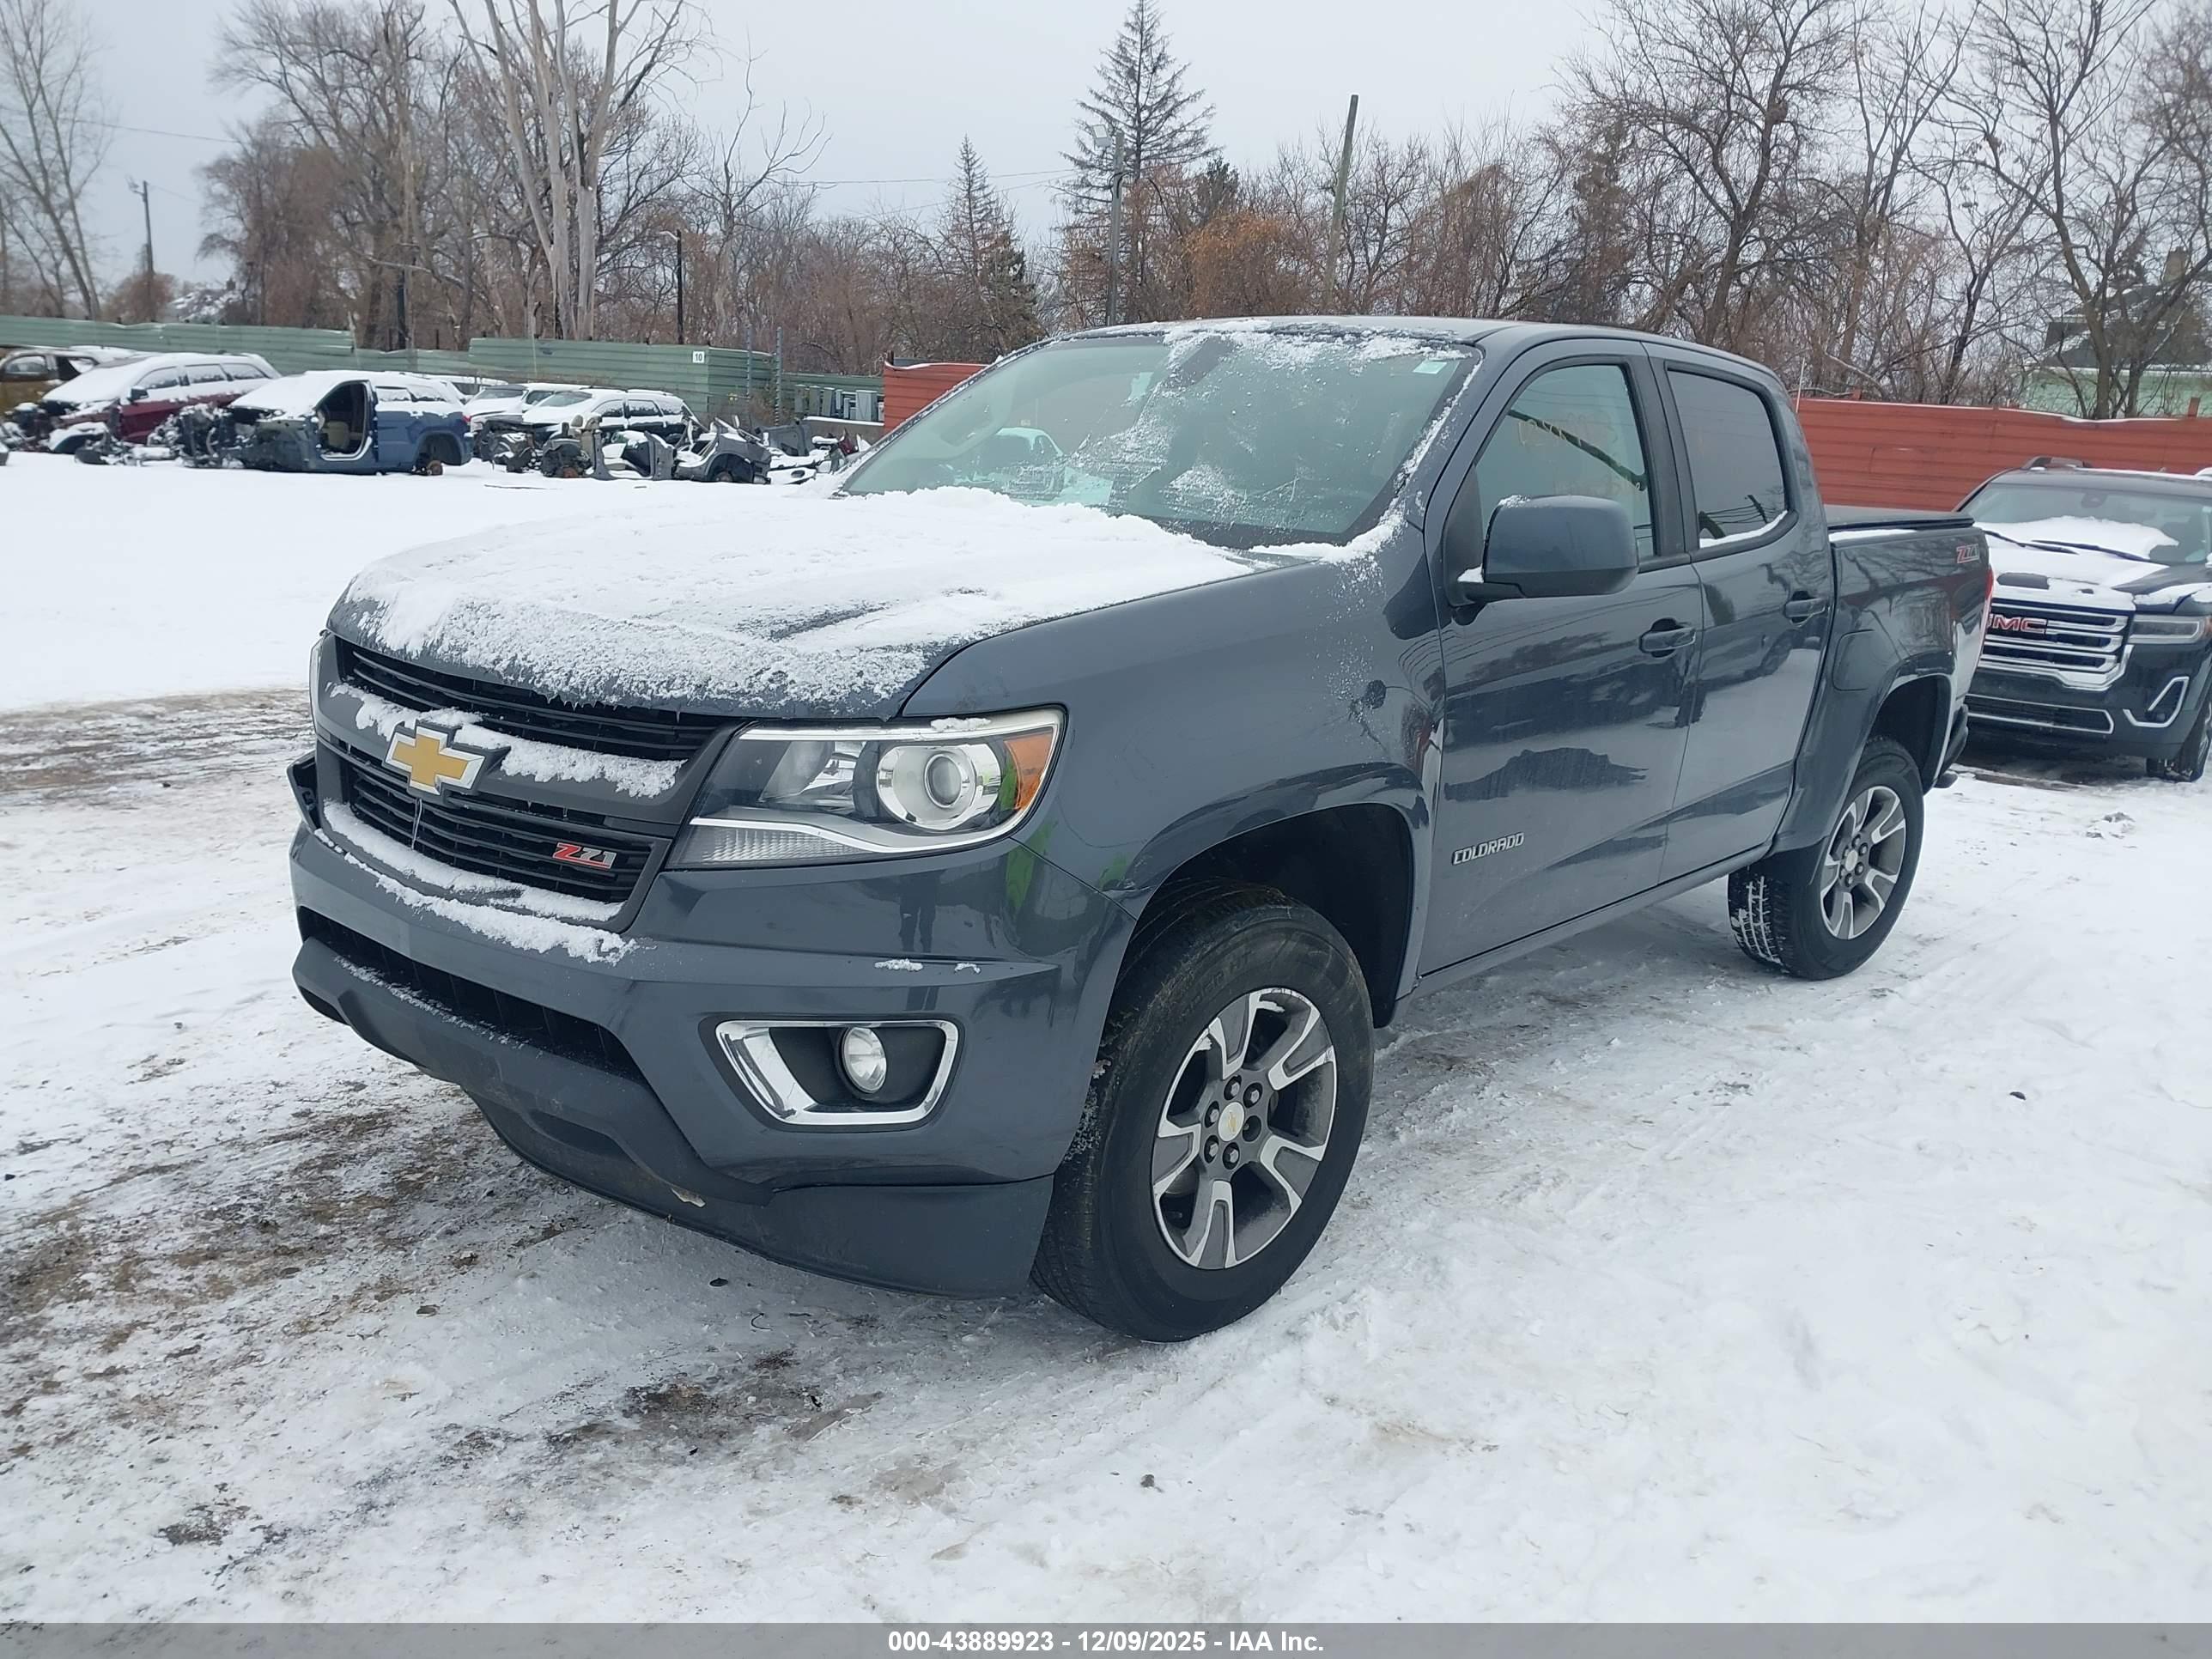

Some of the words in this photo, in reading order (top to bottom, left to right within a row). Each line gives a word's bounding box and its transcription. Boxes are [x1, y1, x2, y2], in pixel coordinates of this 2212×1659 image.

[695, 353, 703, 362] 10
[1956, 544, 1979, 563] Z71
[1988, 613, 2047, 634] MC
[552, 842, 617, 869] Z71
[1452, 832, 1524, 865] COLORADO
